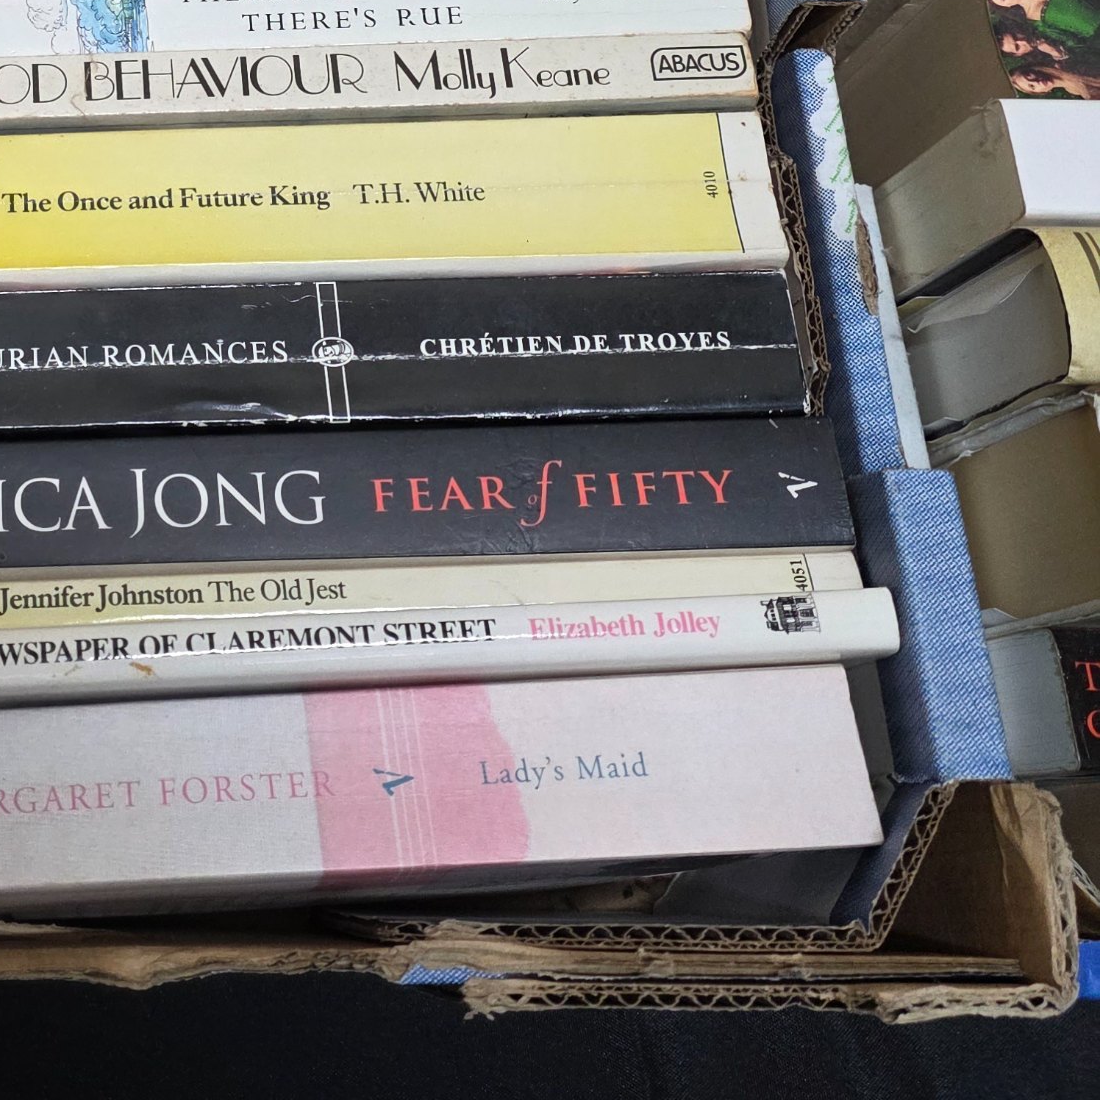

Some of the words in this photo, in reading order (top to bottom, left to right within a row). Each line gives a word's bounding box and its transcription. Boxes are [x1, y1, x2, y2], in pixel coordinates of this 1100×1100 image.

[85, 53, 368, 101] BEHAVIOUR
[393, 48, 497, 99] Molly
[500, 46, 611, 88] Keane
[658, 52, 740, 74] ABACUS
[1, 192, 52, 213] The
[57, 190, 122, 211] Once
[128, 188, 173, 210] and
[179, 186, 264, 207] Future
[268, 184, 331, 210] King
[353, 183, 411, 205] T.H.
[415, 181, 486, 202] White
[703, 170, 718, 199] 4010
[101, 340, 289, 366] ROMANCES
[419, 331, 563, 357] CHRÉTIEN
[575, 334, 608, 353] DE
[619, 330, 731, 350] TROYES
[129, 468, 326, 539] JONG
[371, 475, 516, 513] FEAR
[520, 460, 563, 527] of
[573, 469, 733, 507] FIFTY
[789, 559, 809, 592] 4051
[159, 770, 338, 806] FORSTER
[481, 756, 564, 790] Lady's
[576, 751, 649, 780] Maid
